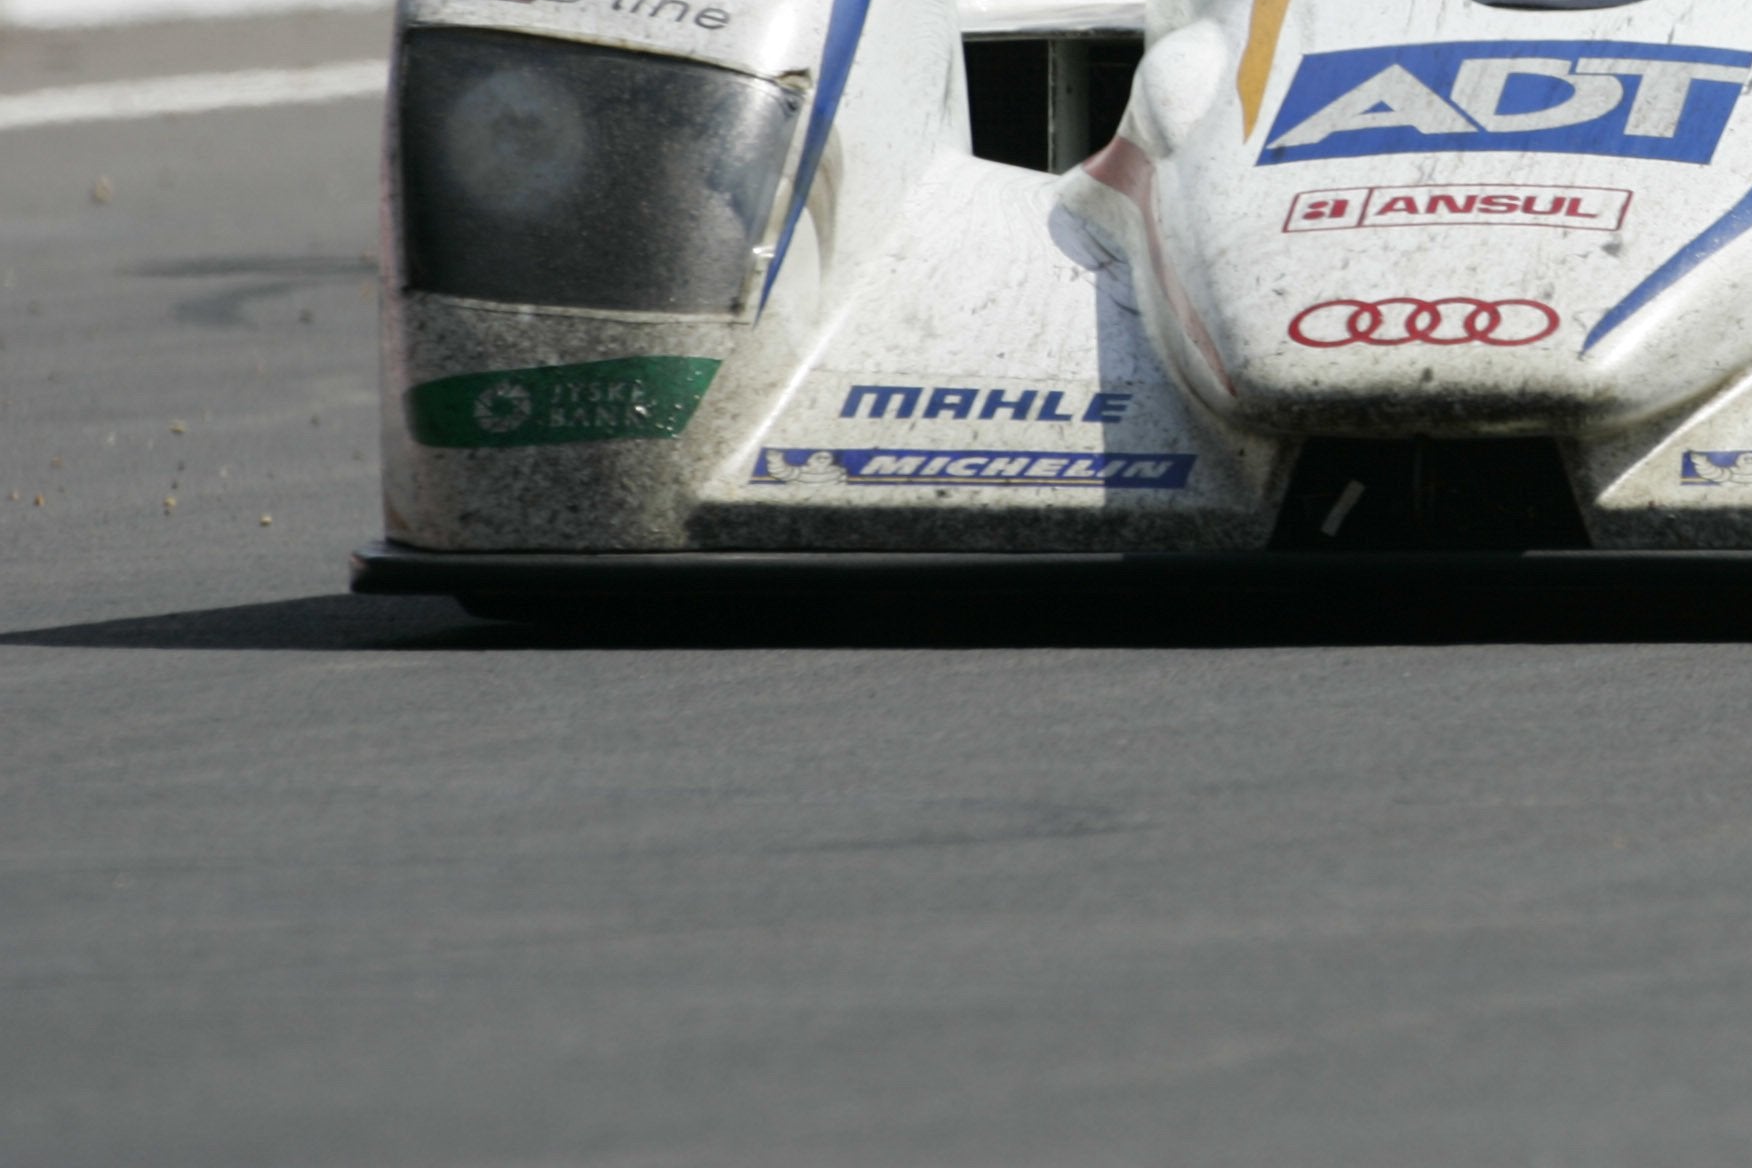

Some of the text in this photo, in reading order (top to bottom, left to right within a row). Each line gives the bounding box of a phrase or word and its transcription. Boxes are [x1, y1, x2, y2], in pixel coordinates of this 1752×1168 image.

[1266, 57, 1752, 149] ADT
[1375, 194, 1601, 219] ANSUL
[839, 384, 1133, 424] MAHLE
[859, 454, 1173, 480] MICHELIN
